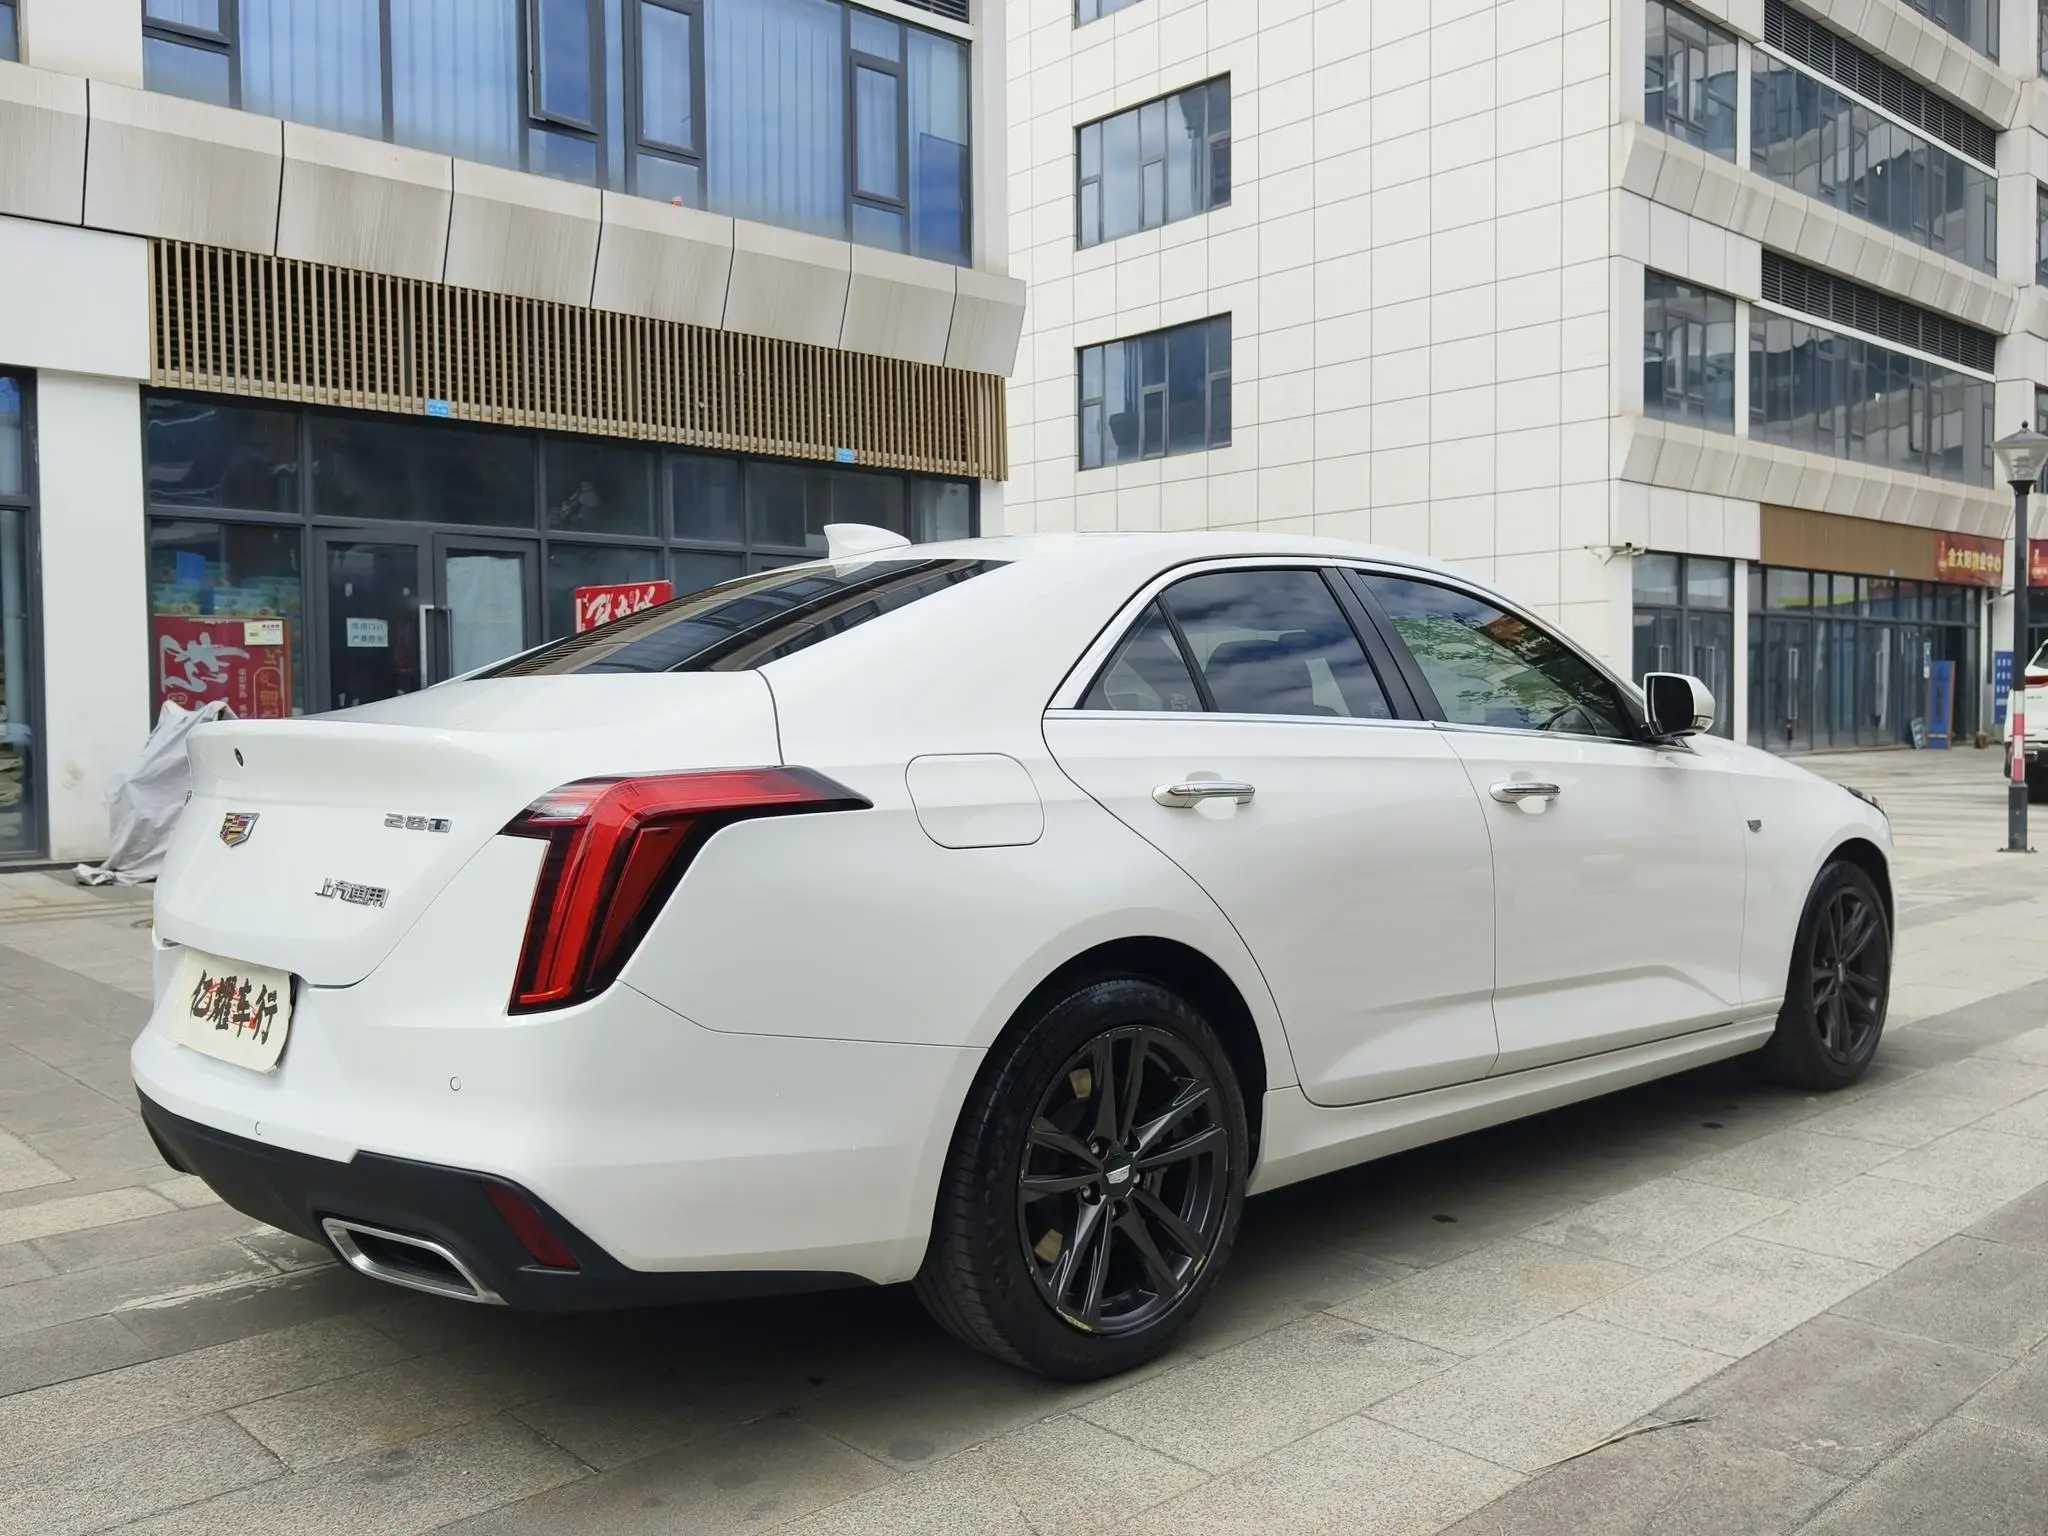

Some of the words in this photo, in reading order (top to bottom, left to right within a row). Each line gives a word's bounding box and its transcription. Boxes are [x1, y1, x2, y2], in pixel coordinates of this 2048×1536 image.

[384, 813, 452, 833] 28T
[314, 878, 389, 908] 上汽通用
